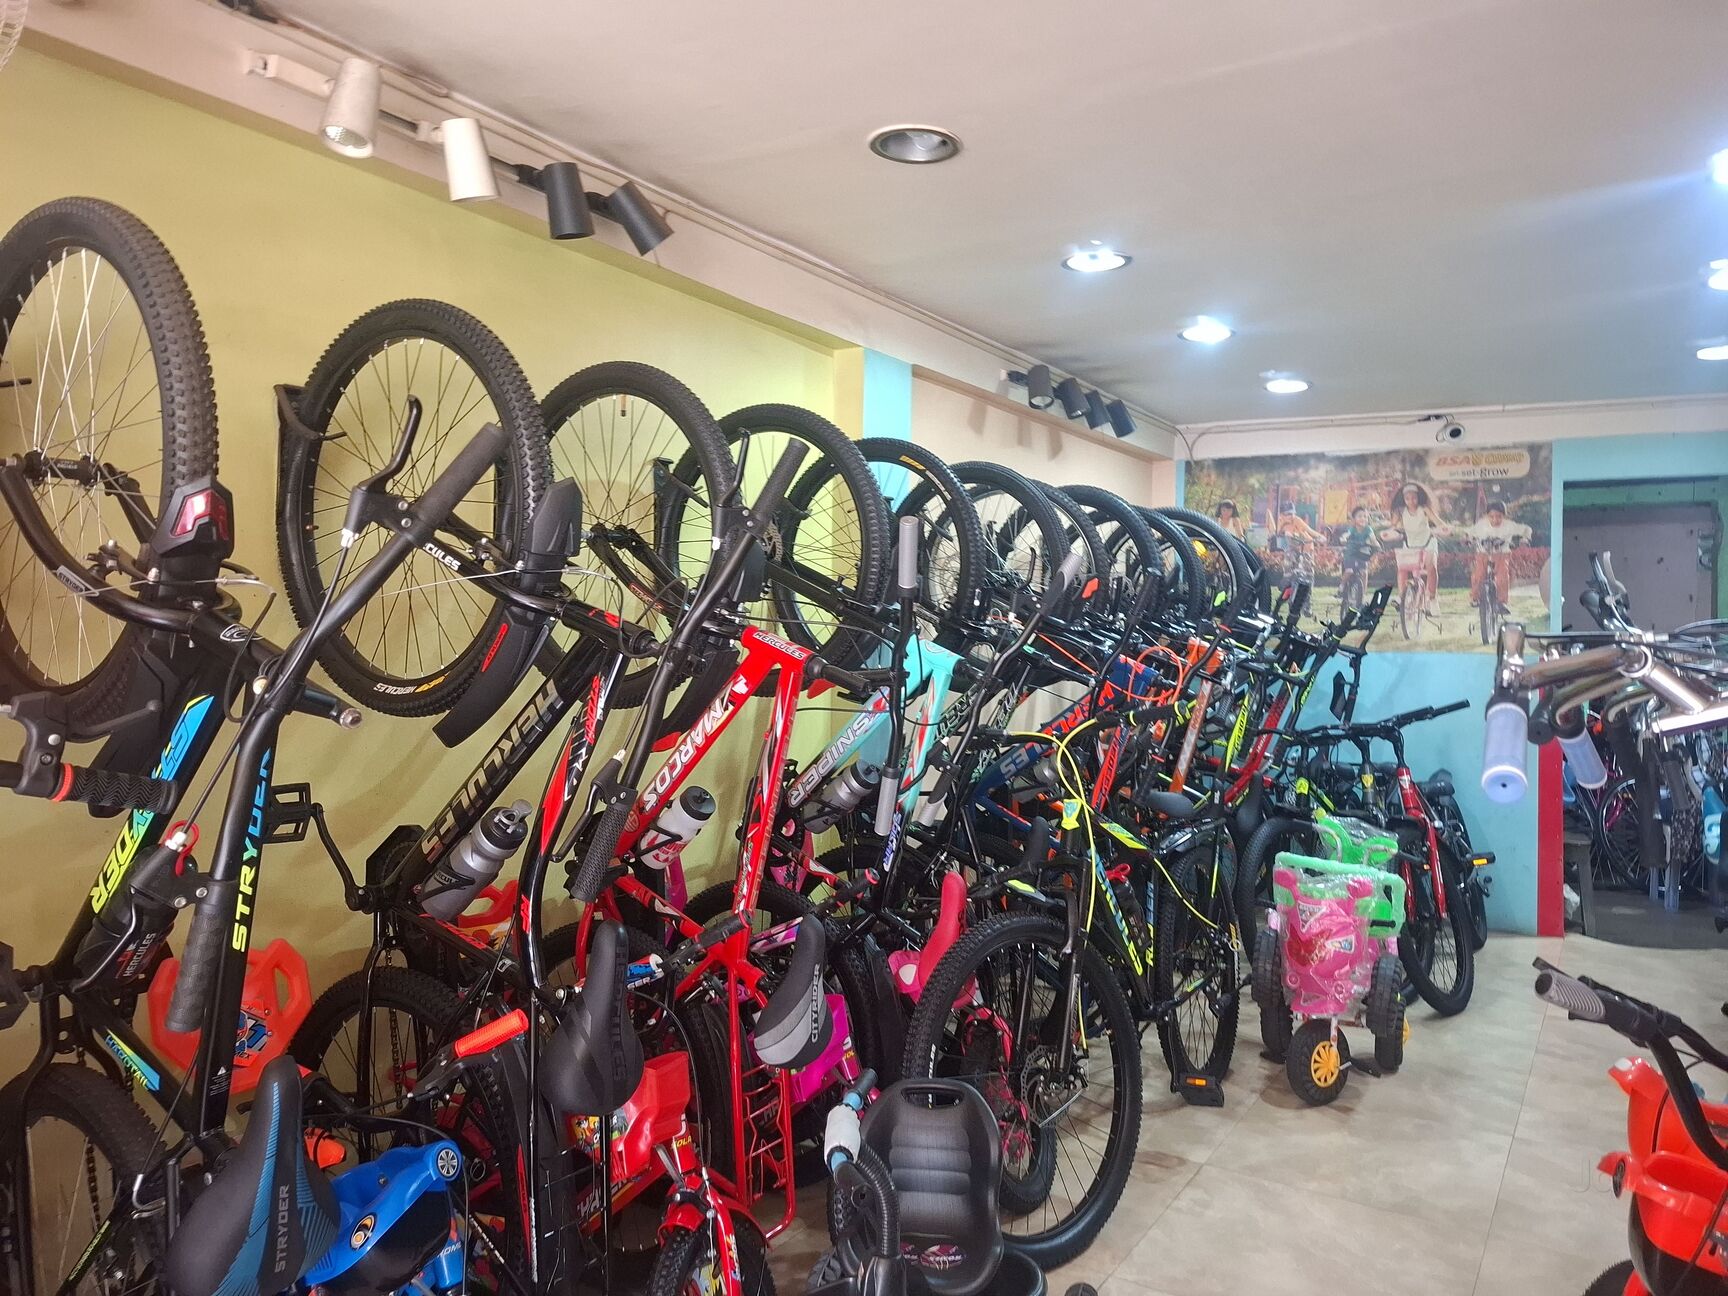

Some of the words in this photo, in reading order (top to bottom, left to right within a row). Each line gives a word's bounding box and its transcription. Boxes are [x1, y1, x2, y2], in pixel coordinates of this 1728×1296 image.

[752, 631, 806, 660] HERCULES
[373, 682, 417, 696] HERCULES
[584, 674, 600, 745] STORM
[419, 679, 564, 857] HERCULES
[643, 698, 731, 812] MARCOS
[788, 713, 875, 809] SNIPER
[90, 720, 191, 914] STYDER
[122, 932, 156, 979] HERCULES
[810, 962, 823, 1044] CITYRIDER
[105, 1035, 150, 1090] HARDTAIL
[274, 1183, 290, 1274] STRYDER
